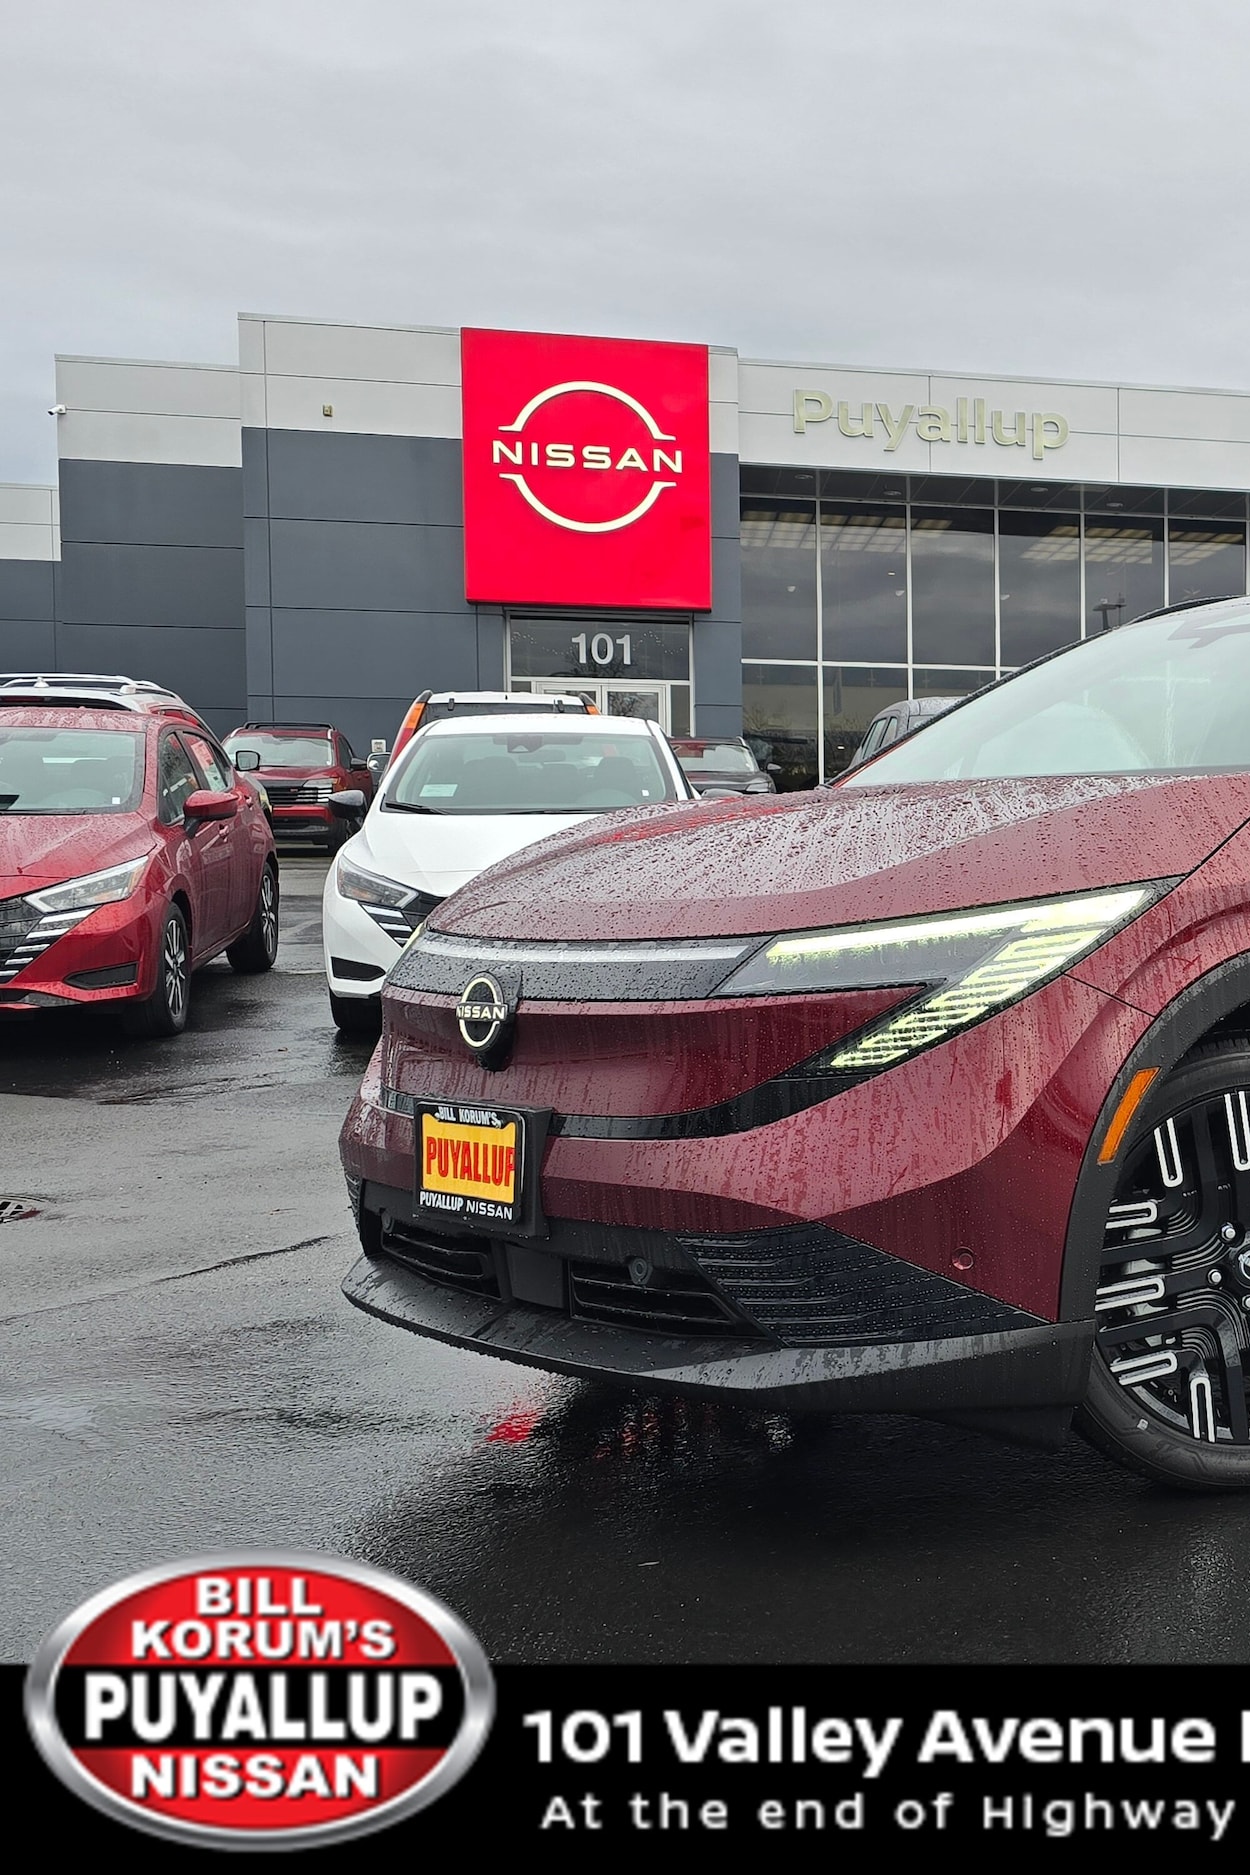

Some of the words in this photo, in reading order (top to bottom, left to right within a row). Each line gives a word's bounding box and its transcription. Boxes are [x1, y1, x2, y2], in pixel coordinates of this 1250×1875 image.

[793, 388, 1069, 460] Puyallup
[492, 440, 683, 473] NISSAN
[572, 633, 631, 665] 101
[437, 1106, 456, 1121] BILL
[459, 1108, 499, 1127] KORUM'S
[420, 1191, 463, 1212] PUYALLUP
[466, 1200, 513, 1220] NISSAN
